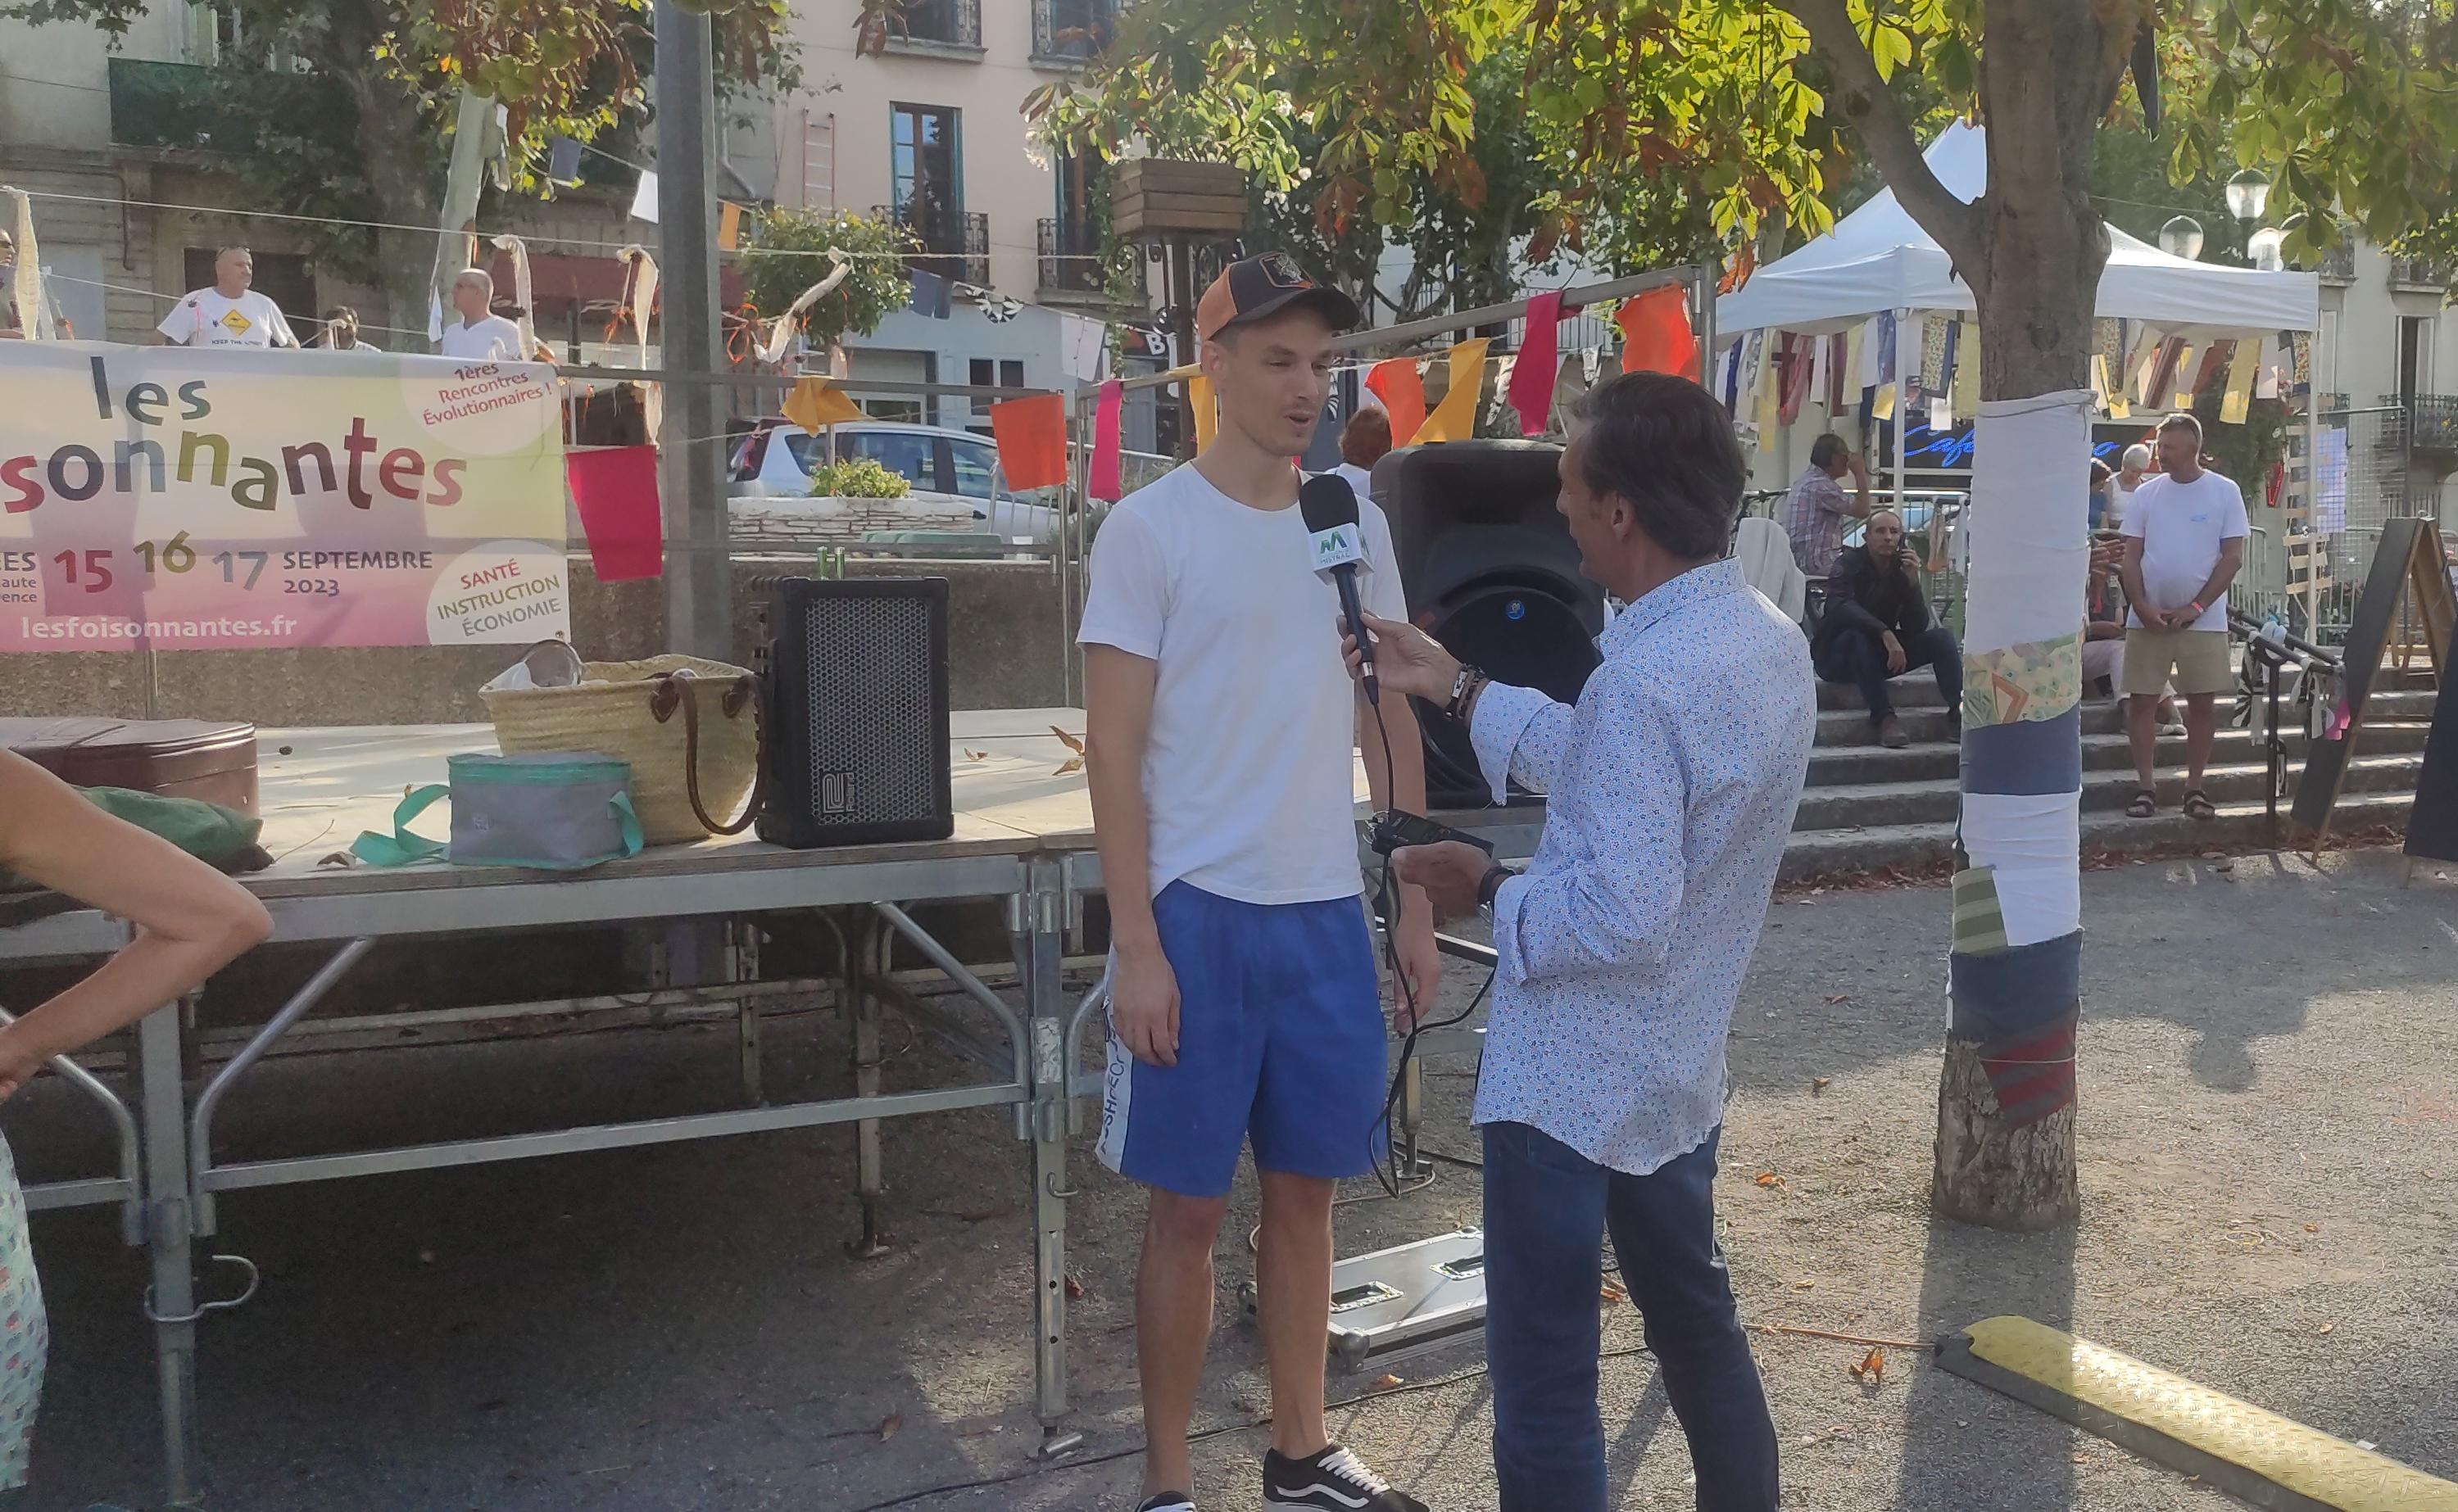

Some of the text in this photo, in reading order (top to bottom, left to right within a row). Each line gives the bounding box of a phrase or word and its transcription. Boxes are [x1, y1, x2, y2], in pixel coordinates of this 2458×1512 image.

[438, 372, 529, 404] Rencontres
[454, 363, 499, 382] 1ères
[90, 356, 212, 426] les
[423, 387, 542, 425] Évolutionnaires
[0, 417, 468, 514] sonnantes
[0, 551, 36, 572] ES
[133, 529, 197, 573] 16
[283, 550, 433, 570] SEPTEMBRE
[1321, 552, 1350, 564] MISTRAL
[53, 549, 113, 593] 15
[212, 550, 269, 591] 17
[283, 578, 340, 597] 2023
[460, 558, 521, 590] SANTÉ
[437, 574, 560, 620] INSTRUCTION
[22, 614, 297, 639] lesfoisonnantes.fr
[462, 598, 562, 636] ÉCONOMIE
